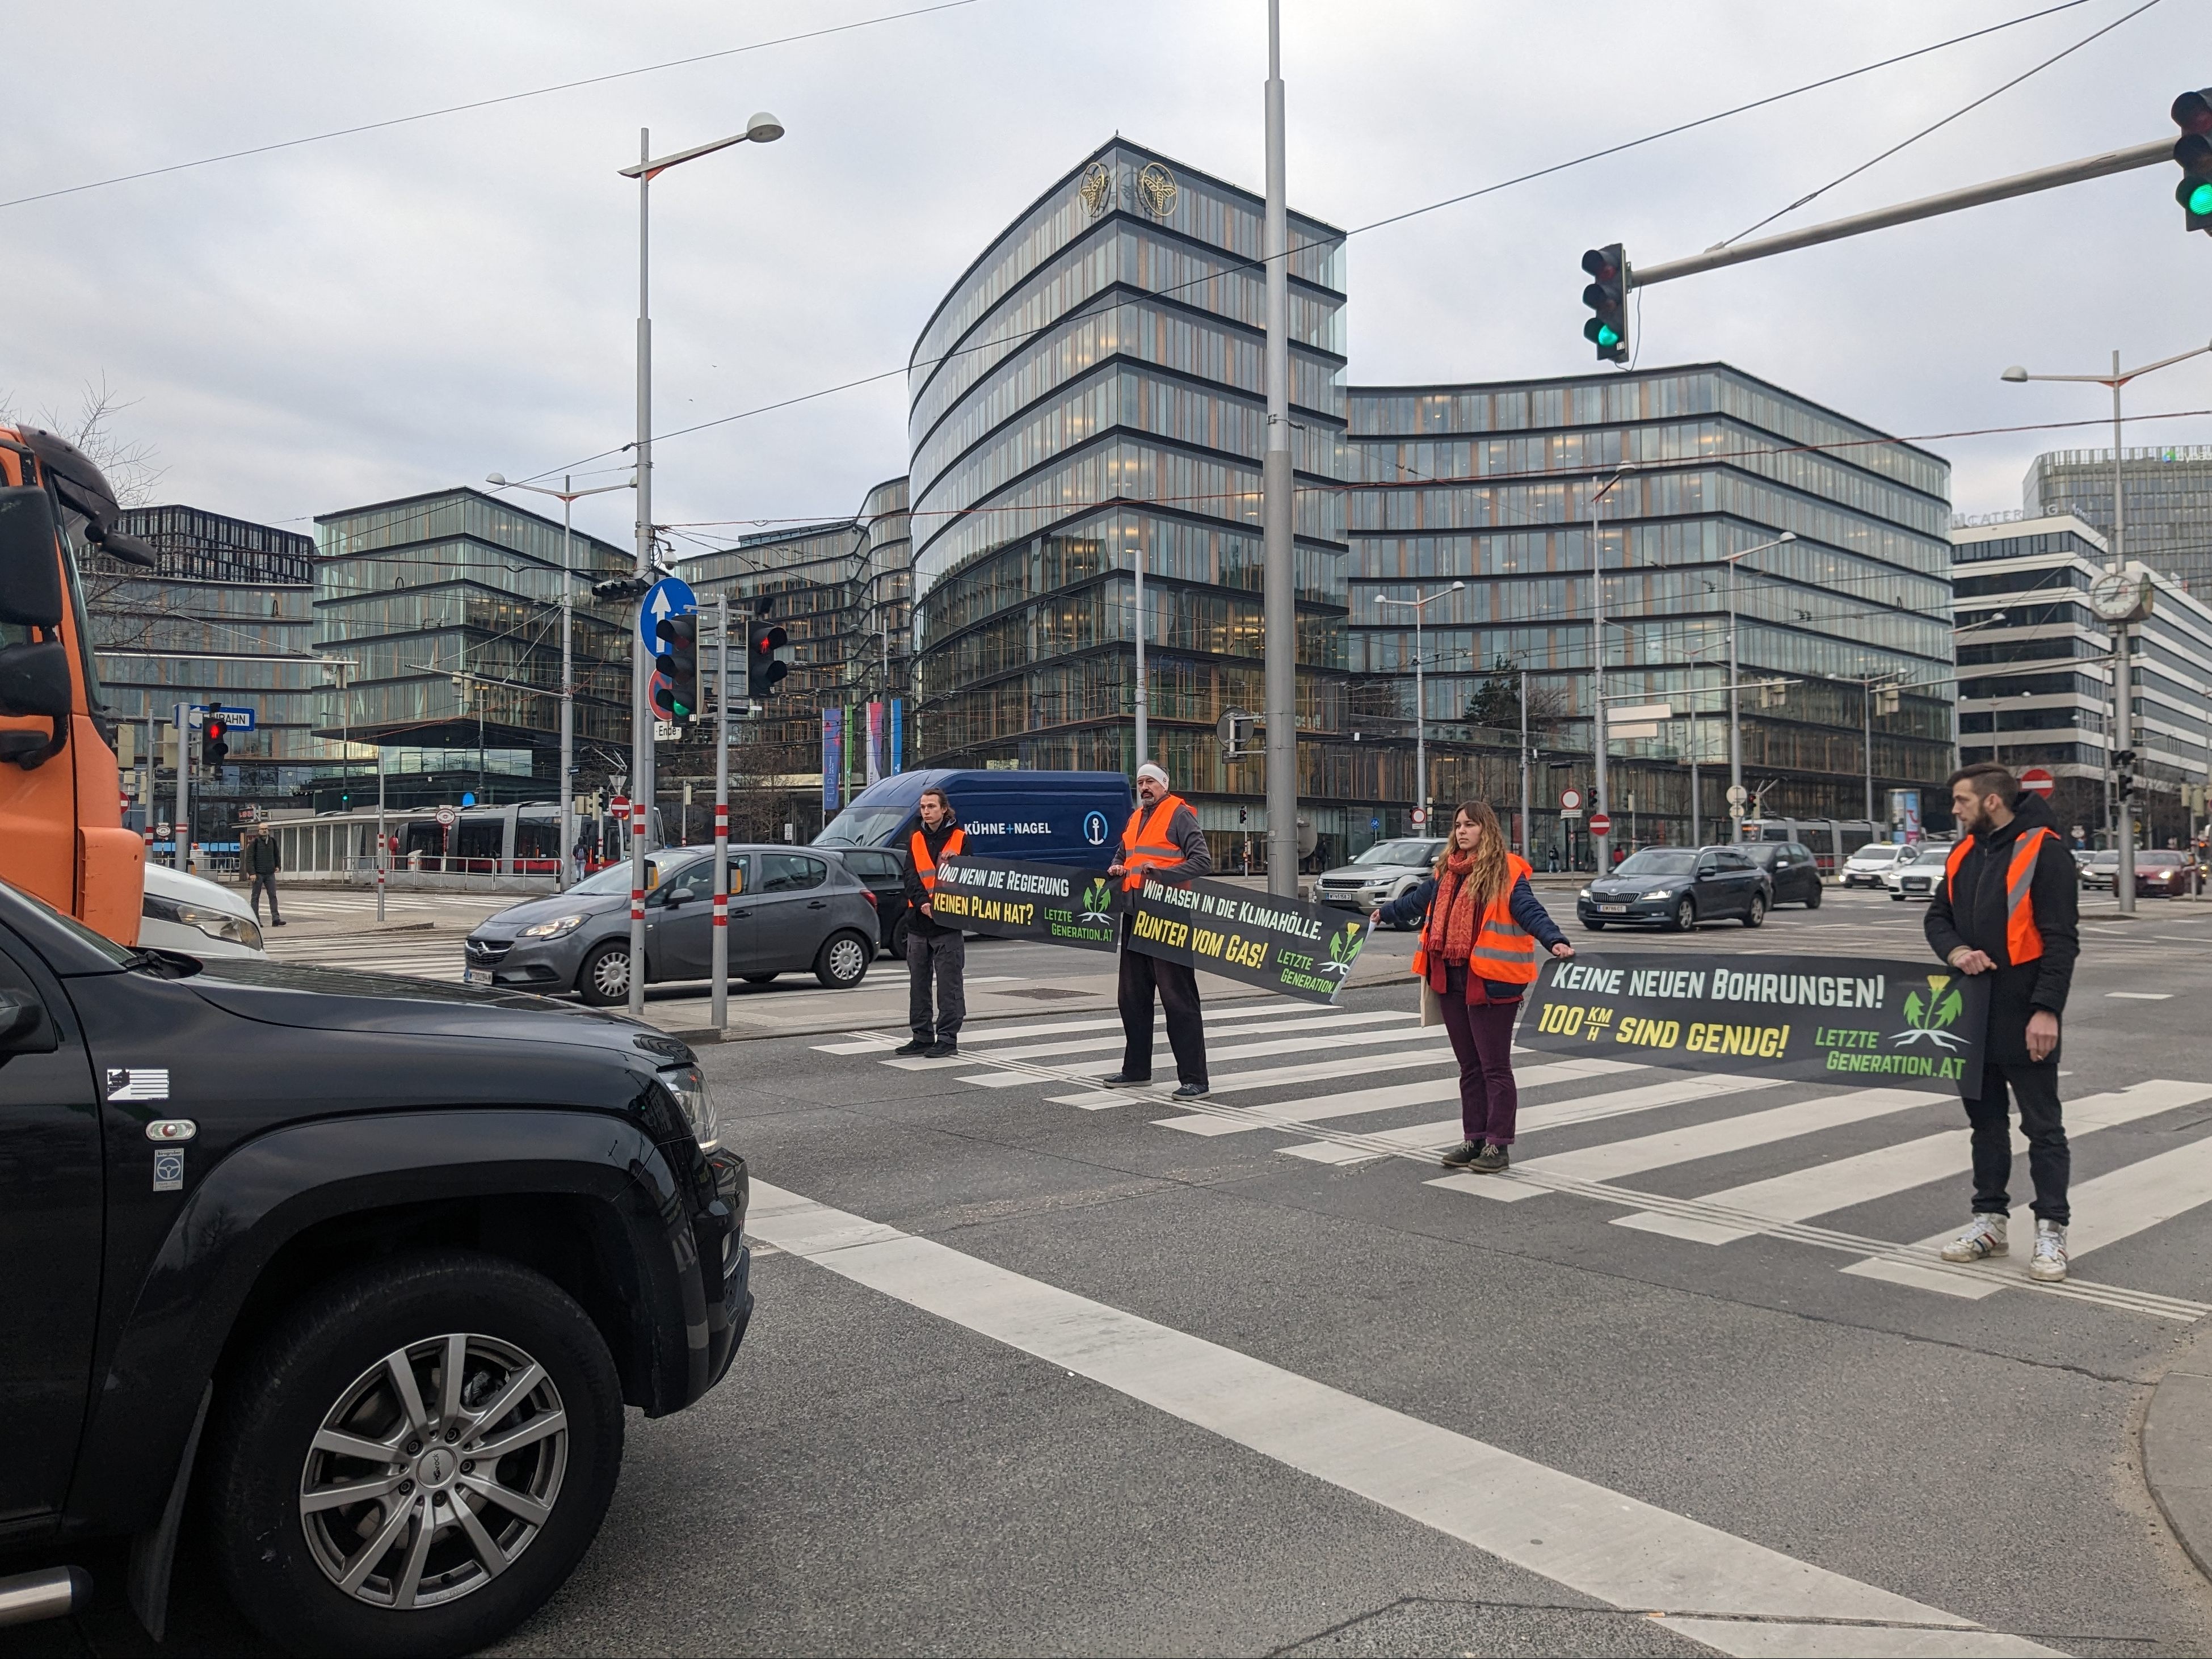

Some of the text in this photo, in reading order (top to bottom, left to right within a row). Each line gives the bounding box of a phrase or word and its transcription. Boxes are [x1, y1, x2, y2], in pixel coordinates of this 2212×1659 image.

[659, 725, 676, 736] Ende
[937, 862, 1069, 897] UND WENN DIE REGIERUNG
[933, 892, 1034, 925] KEINEN PLAN HAT?
[1044, 907, 1073, 923] LETZTE
[1142, 879, 1323, 941] WIR RASEN IN DIE KLIMAHÖLLE.
[1052, 923, 1113, 942] GENERATION.AT
[1133, 910, 1269, 969] RUNTER VOM GAS!
[1277, 949, 1314, 971] LETZTE
[1551, 962, 1884, 1009] KEINE NEUEN BOHRUNGEN!
[1538, 1003, 1584, 1036] 100
[1616, 1017, 1680, 1049] SIND
[1685, 1022, 1790, 1059] GENUG!
[1815, 1026, 1879, 1049] LETZTE
[1826, 1050, 1966, 1080] GENERATION.AT
